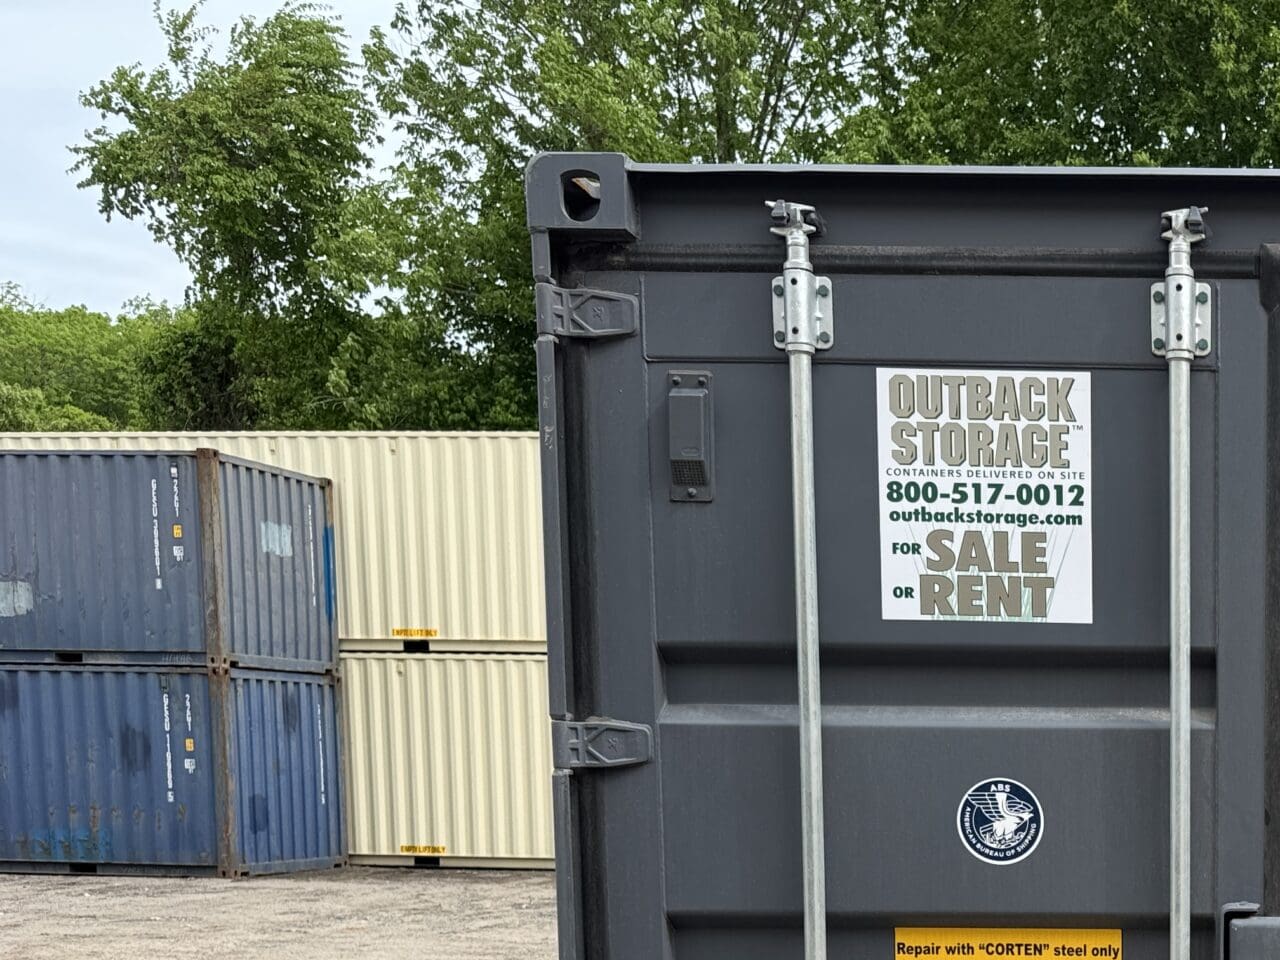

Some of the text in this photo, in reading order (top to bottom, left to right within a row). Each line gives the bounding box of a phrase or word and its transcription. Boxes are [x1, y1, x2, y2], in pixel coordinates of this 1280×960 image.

[888, 374, 1077, 422] OUTBACK
[890, 421, 1070, 469] STORAGE
[886, 468, 1086, 480] CONTAINERS DELIVERED ON SITE
[886, 481, 1085, 506] 800-517-0012
[889, 506, 1083, 528] outbackstorage.com
[892, 529, 1048, 574] FOR SALE
[893, 573, 1055, 618] OR RENT
[990, 783, 1011, 792] ABS
[963, 805, 1037, 857] AMERICAN BUREAU OF SHIPPING
[896, 942, 941, 958] Repair
[944, 943, 974, 956] with
[1053, 944, 1087, 957] steel
[1091, 944, 1120, 960] only
